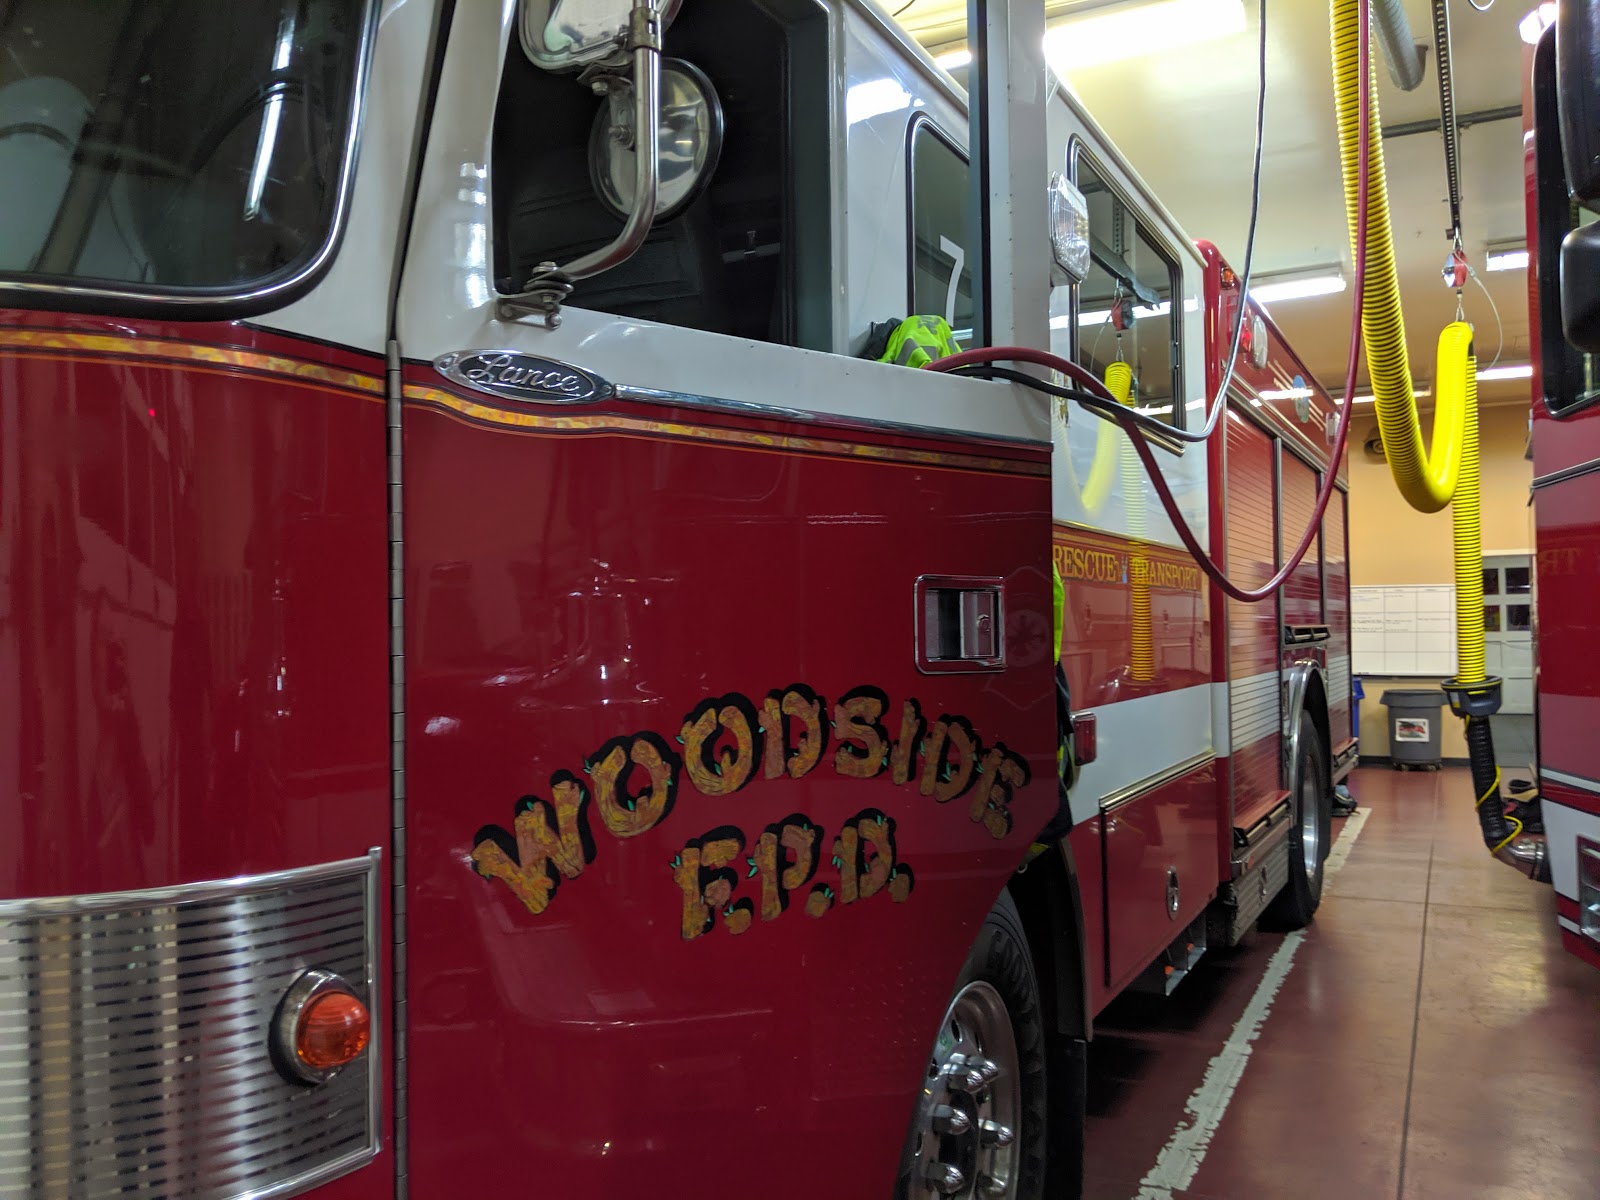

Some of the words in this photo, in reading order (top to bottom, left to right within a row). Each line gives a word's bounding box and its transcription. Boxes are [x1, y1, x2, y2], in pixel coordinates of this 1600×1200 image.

[939, 235, 965, 327] 7
[466, 354, 581, 392] Lance
[1053, 545, 1118, 583] RESCUE
[472, 683, 1031, 914] WOODSIDE
[671, 808, 914, 940] F.P.D.
